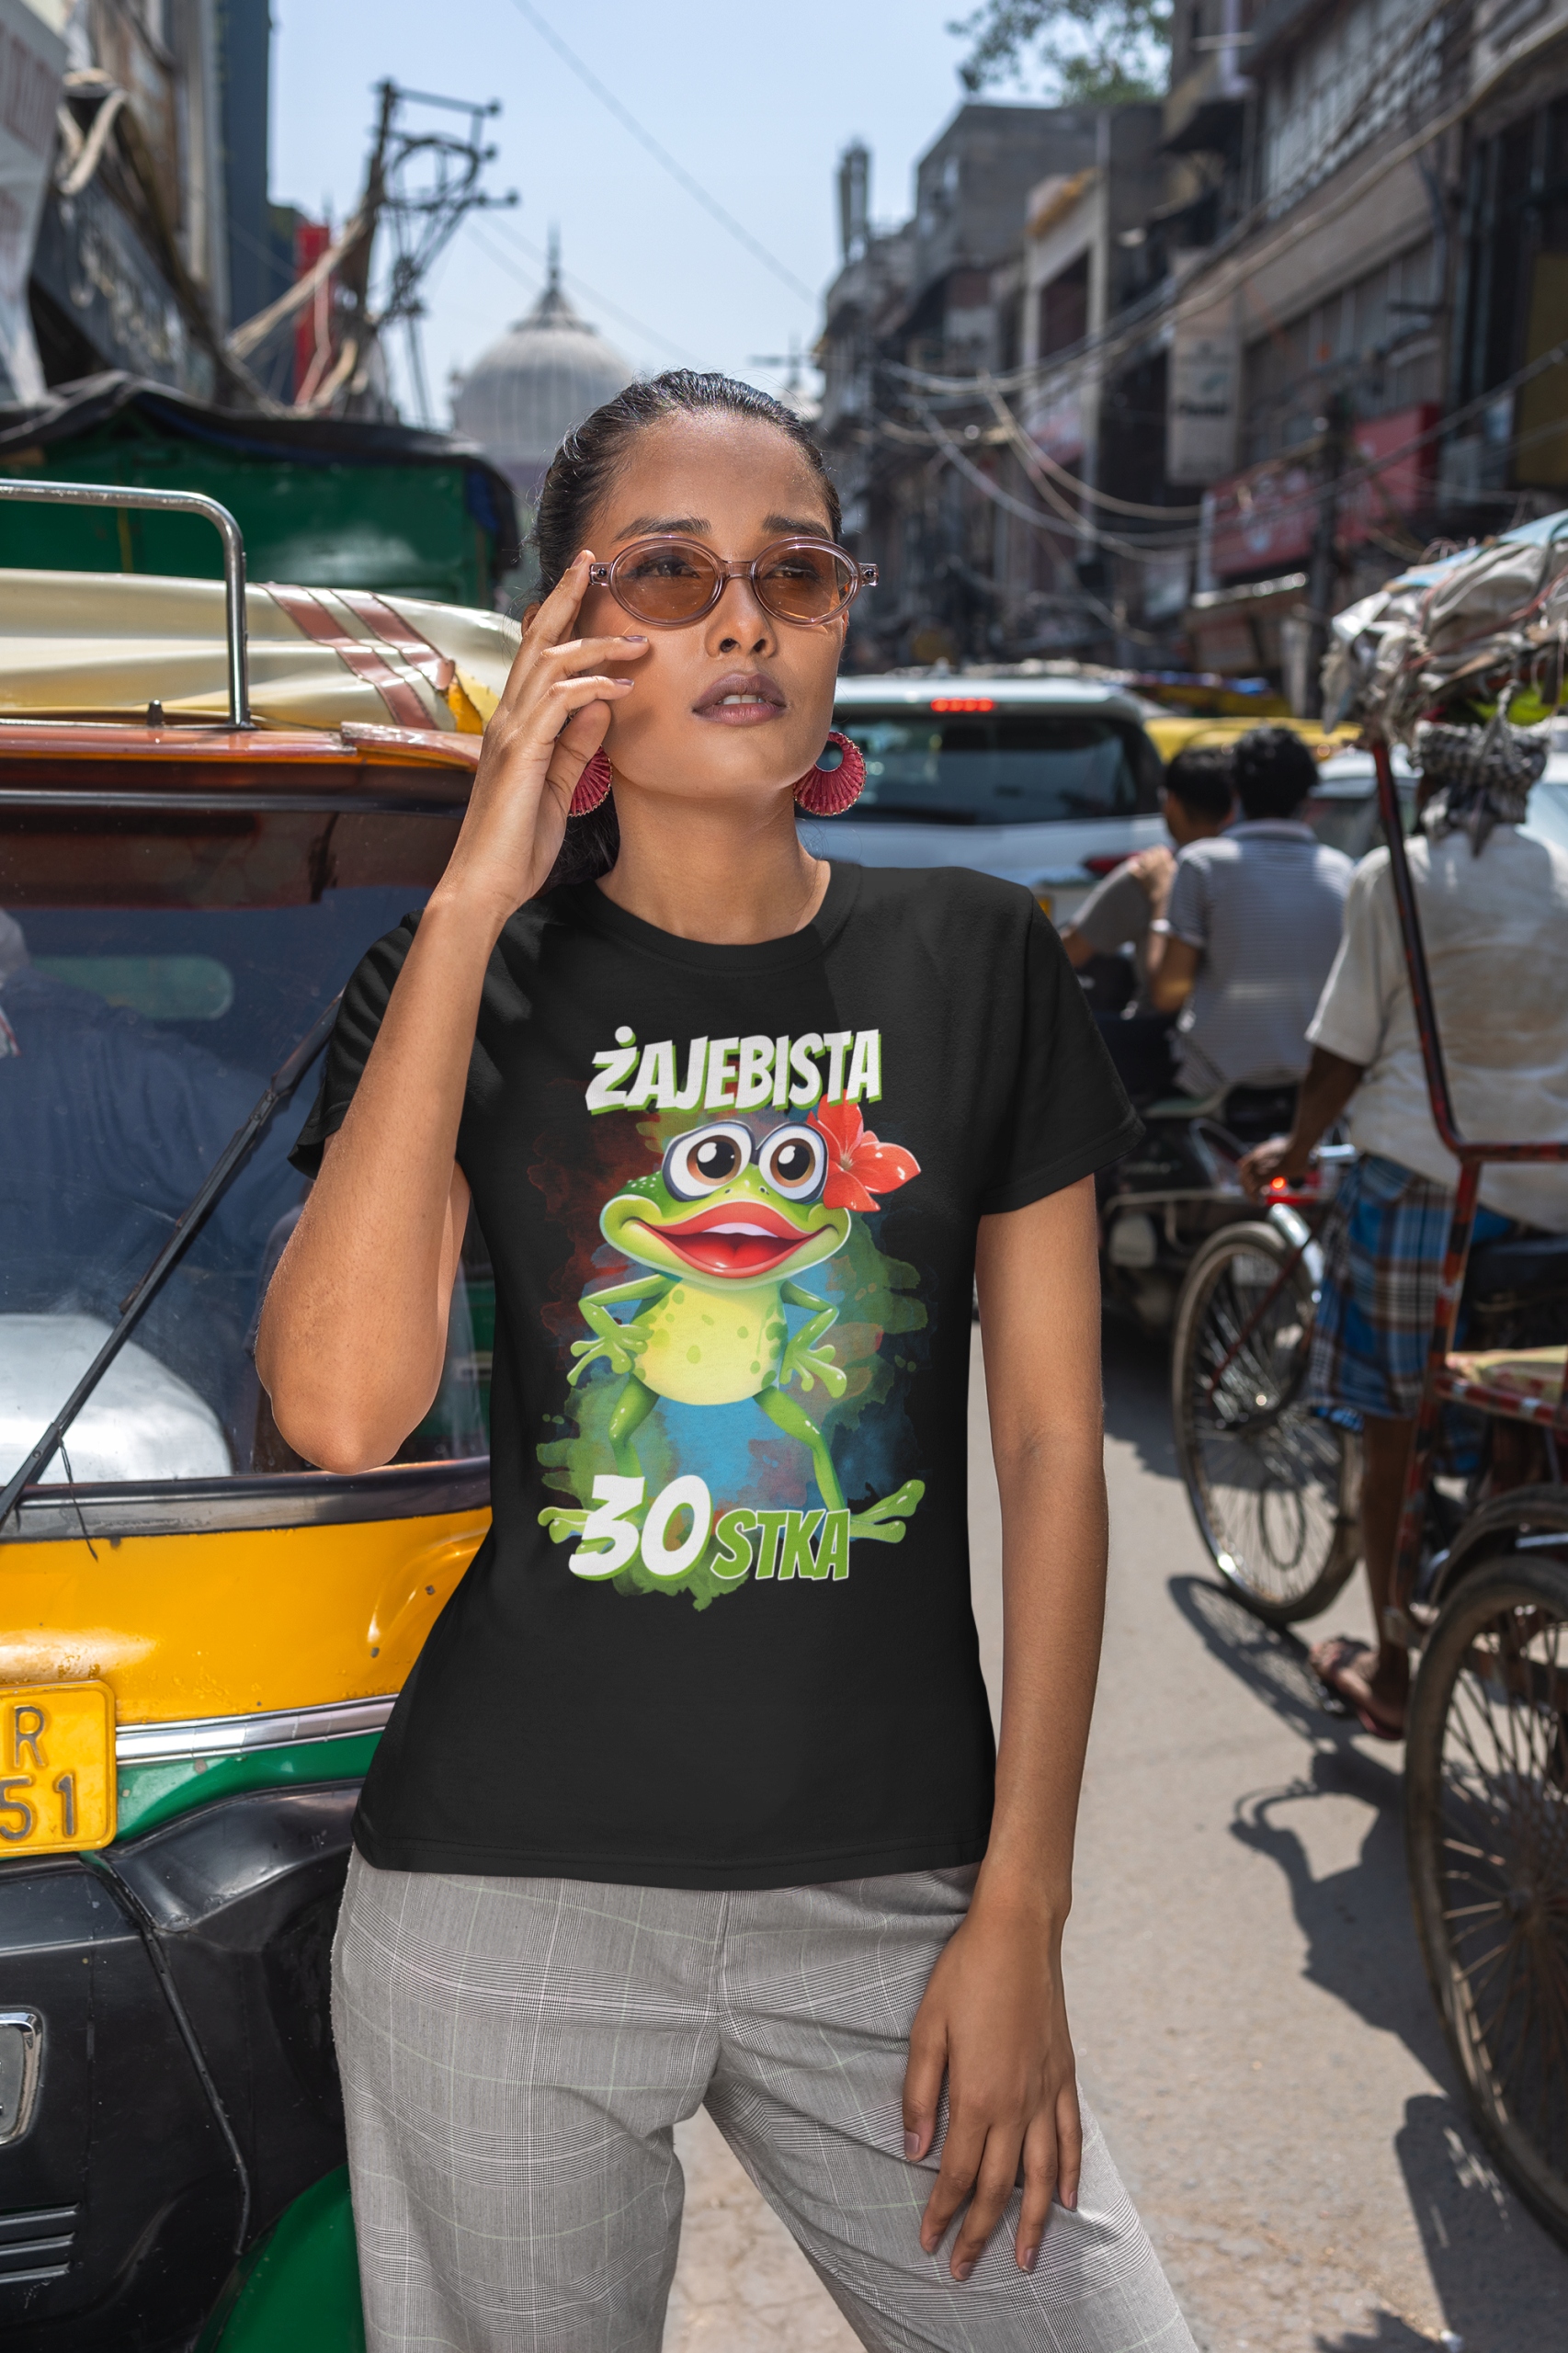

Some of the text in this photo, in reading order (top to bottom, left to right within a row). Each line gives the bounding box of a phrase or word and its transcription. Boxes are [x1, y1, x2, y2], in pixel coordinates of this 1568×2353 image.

[585, 1025, 882, 1115] ŻAJEBISTA
[14, 1705, 46, 1768] R
[0, 1774, 74, 1841] 51
